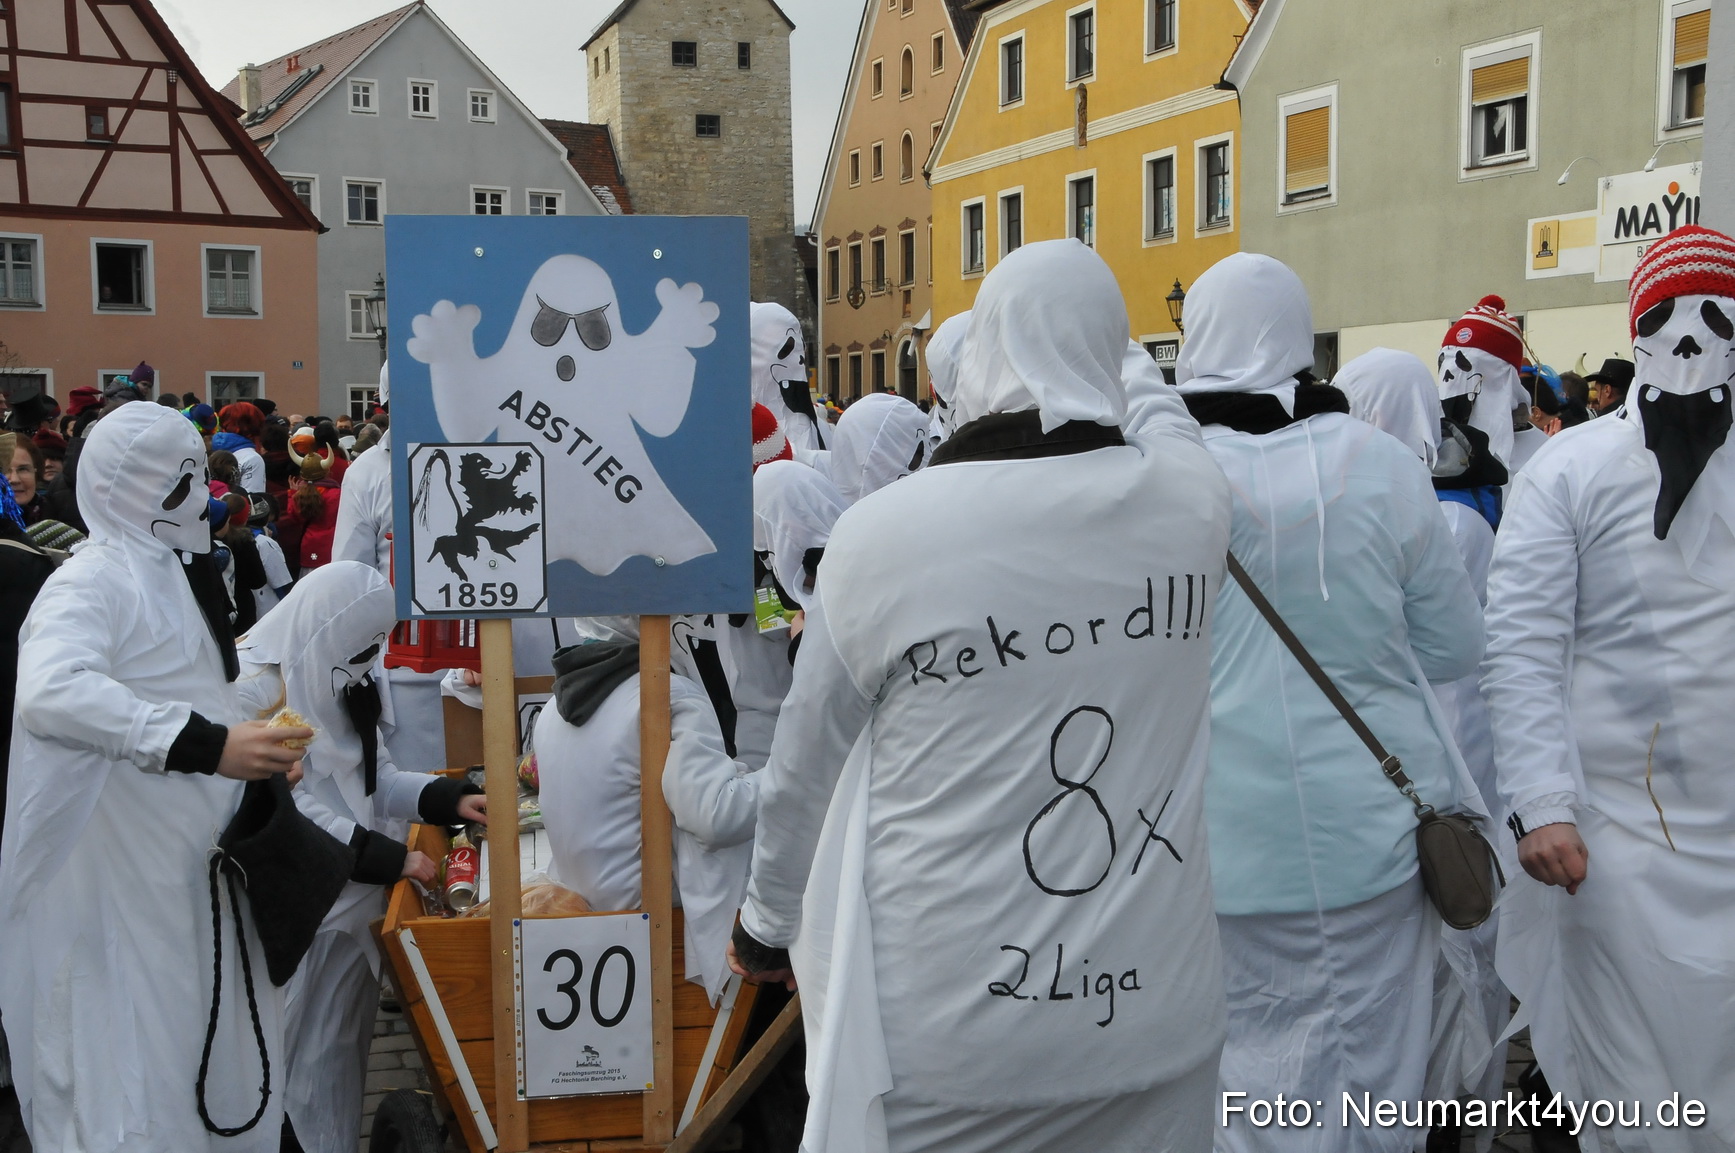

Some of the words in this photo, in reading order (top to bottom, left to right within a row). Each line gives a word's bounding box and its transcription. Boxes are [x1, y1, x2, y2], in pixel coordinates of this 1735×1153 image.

[1614, 192, 1700, 239] MAYI
[1157, 346, 1174, 360] BW
[498, 389, 643, 504] ABSTIEG
[438, 582, 518, 608] 1859
[902, 574, 1206, 685] Rekord!!!
[536, 945, 636, 1031] 30
